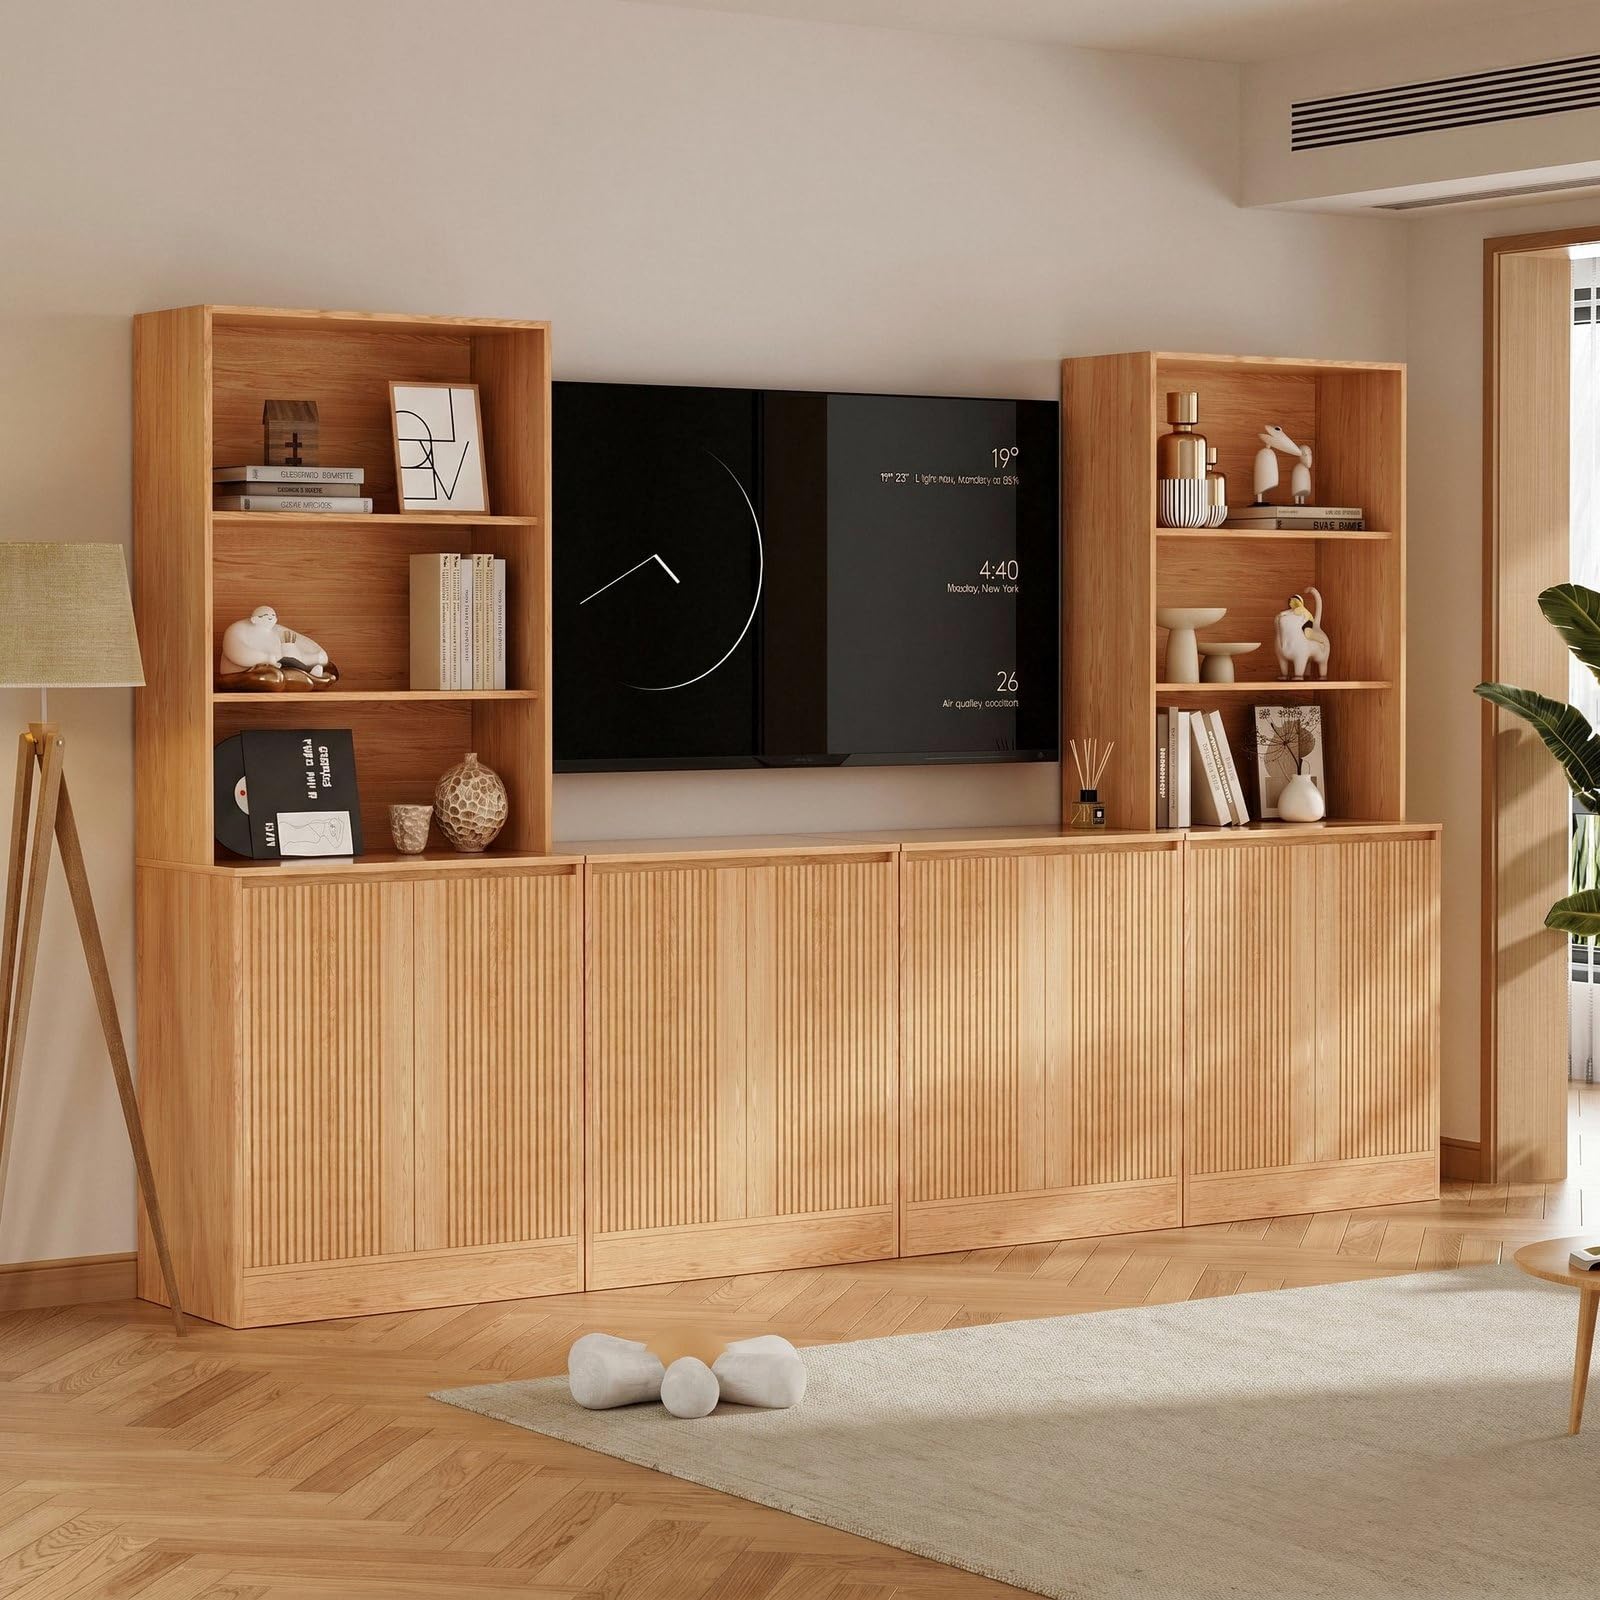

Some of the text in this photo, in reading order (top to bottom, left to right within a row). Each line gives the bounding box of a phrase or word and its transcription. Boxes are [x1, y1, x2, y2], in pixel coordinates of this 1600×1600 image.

[991, 446, 1019, 468] 19°
[979, 560, 1019, 580] 4:40
[981, 584, 1000, 593] New
[1002, 584, 1019, 593] York
[996, 670, 1019, 692] 26
[942, 699, 954, 708] Air
